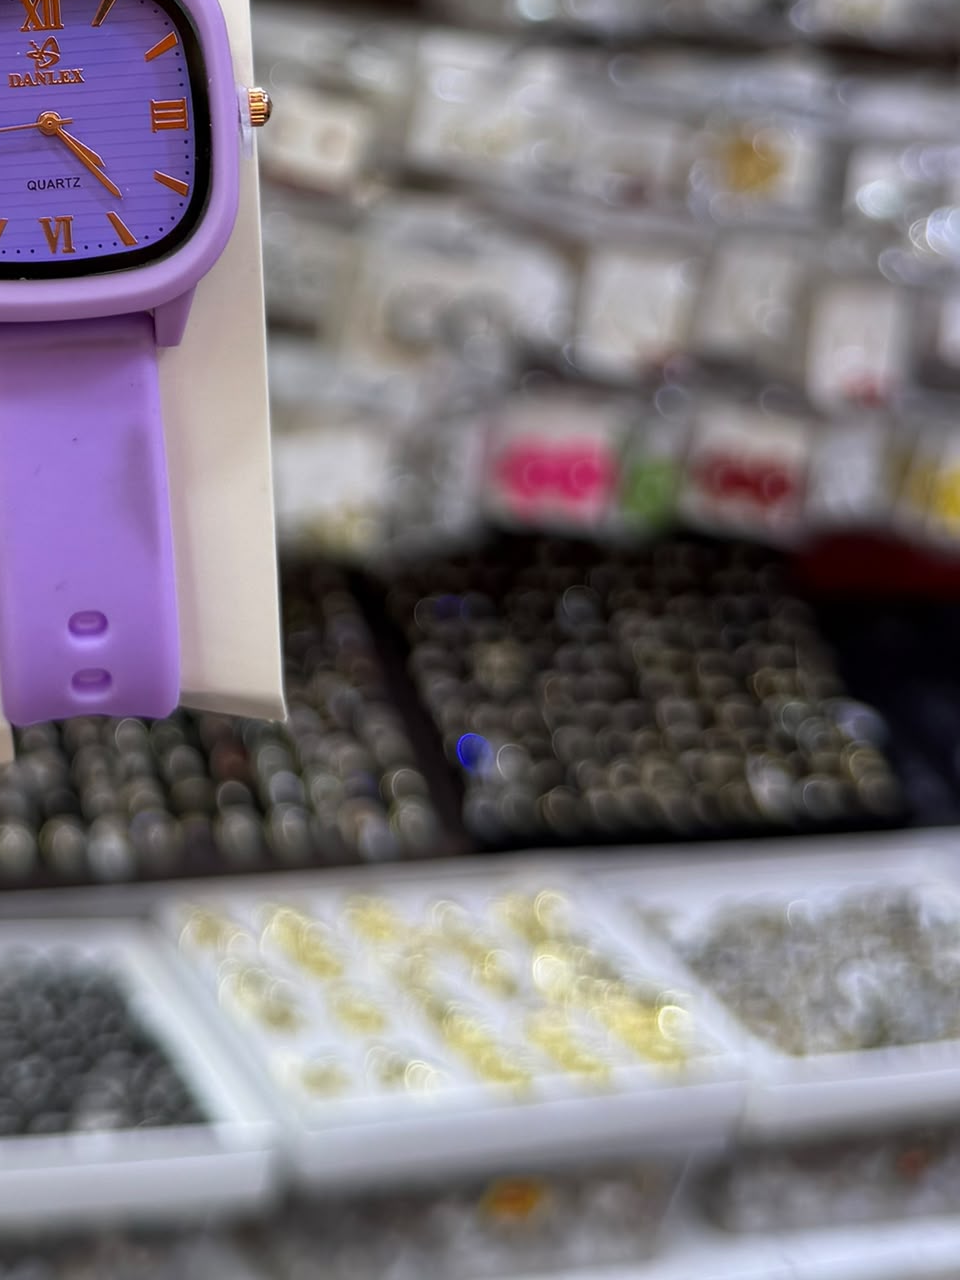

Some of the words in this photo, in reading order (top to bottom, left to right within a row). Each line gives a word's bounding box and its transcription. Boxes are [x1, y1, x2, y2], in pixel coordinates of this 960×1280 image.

[8, 68, 86, 88] DANLEX
[150, 96, 189, 133] III
[26, 176, 82, 191] QUARTZ
[39, 215, 76, 254] VI
